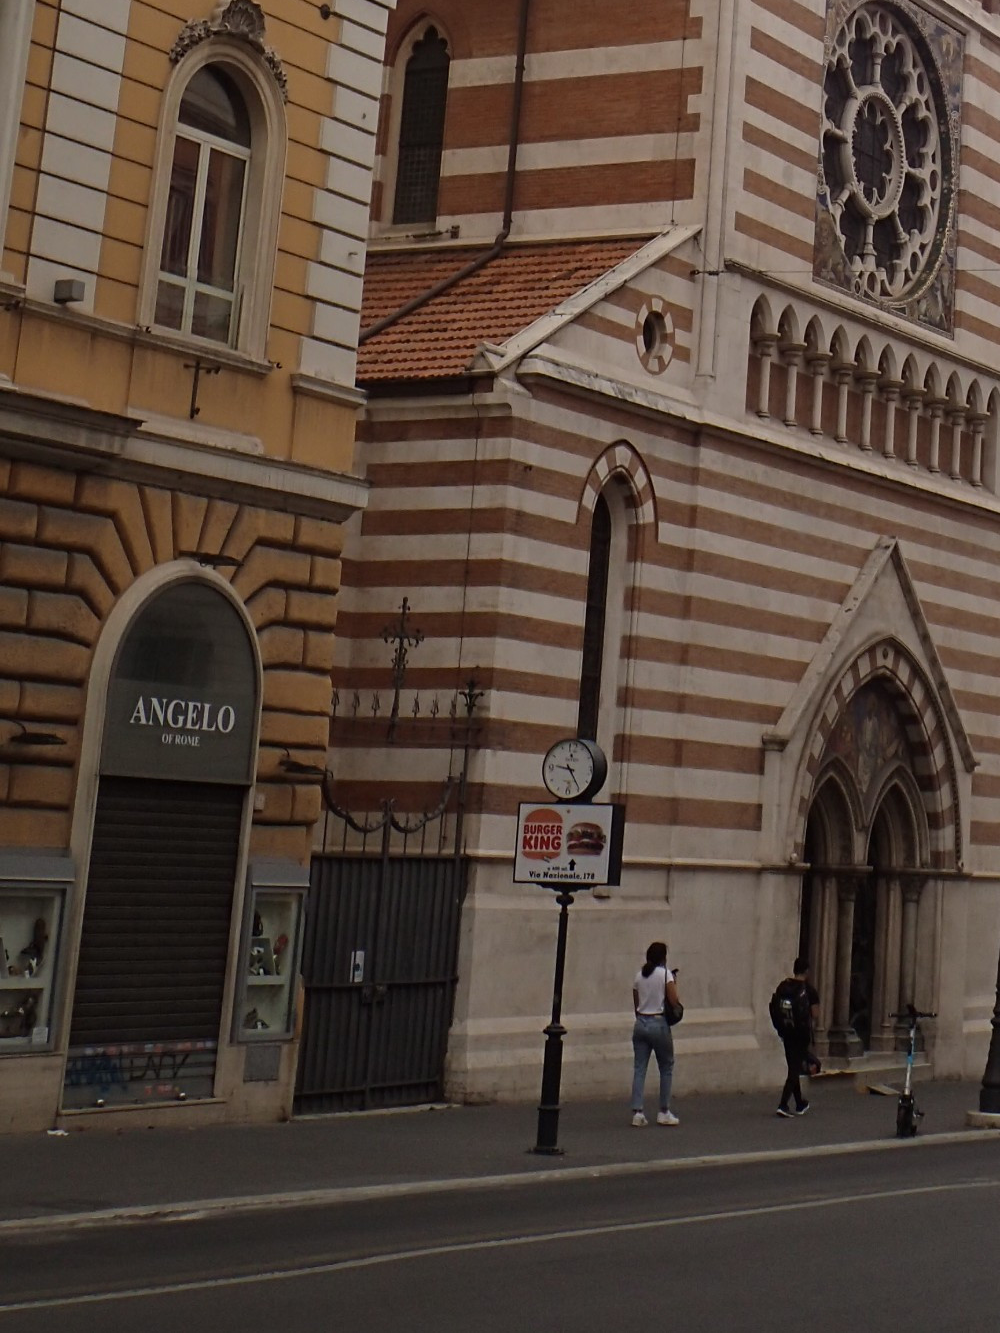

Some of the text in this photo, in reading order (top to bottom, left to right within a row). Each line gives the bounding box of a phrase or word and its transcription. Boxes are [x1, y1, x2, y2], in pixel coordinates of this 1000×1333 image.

[129, 695, 236, 734] ANGELO
[161, 733, 200, 747] OF ROME
[523, 824, 562, 836] BURGER
[522, 835, 562, 851] KING
[529, 870, 541, 878] Via
